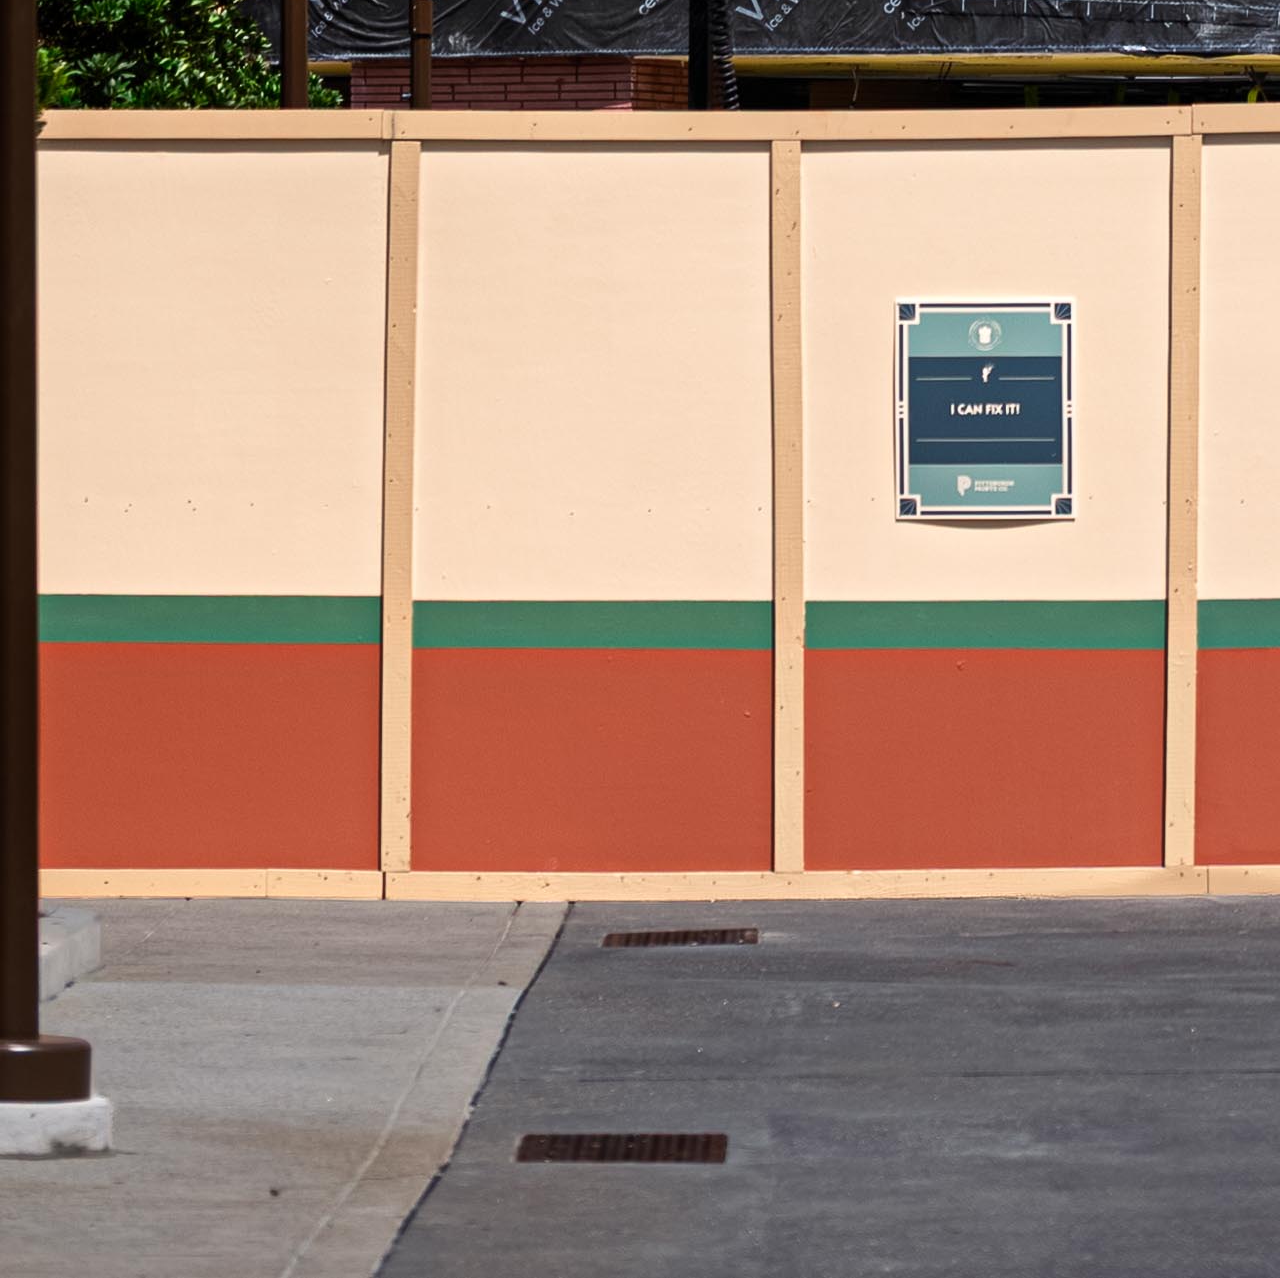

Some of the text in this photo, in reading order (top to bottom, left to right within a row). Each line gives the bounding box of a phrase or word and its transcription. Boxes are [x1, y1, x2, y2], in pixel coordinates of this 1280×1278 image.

[527, 16, 545, 35] Ice
[541, 6, 554, 19] &
[765, 13, 784, 32] Ice
[780, 2, 793, 16] &
[950, 403, 1020, 415] I CAN FIX IT!
